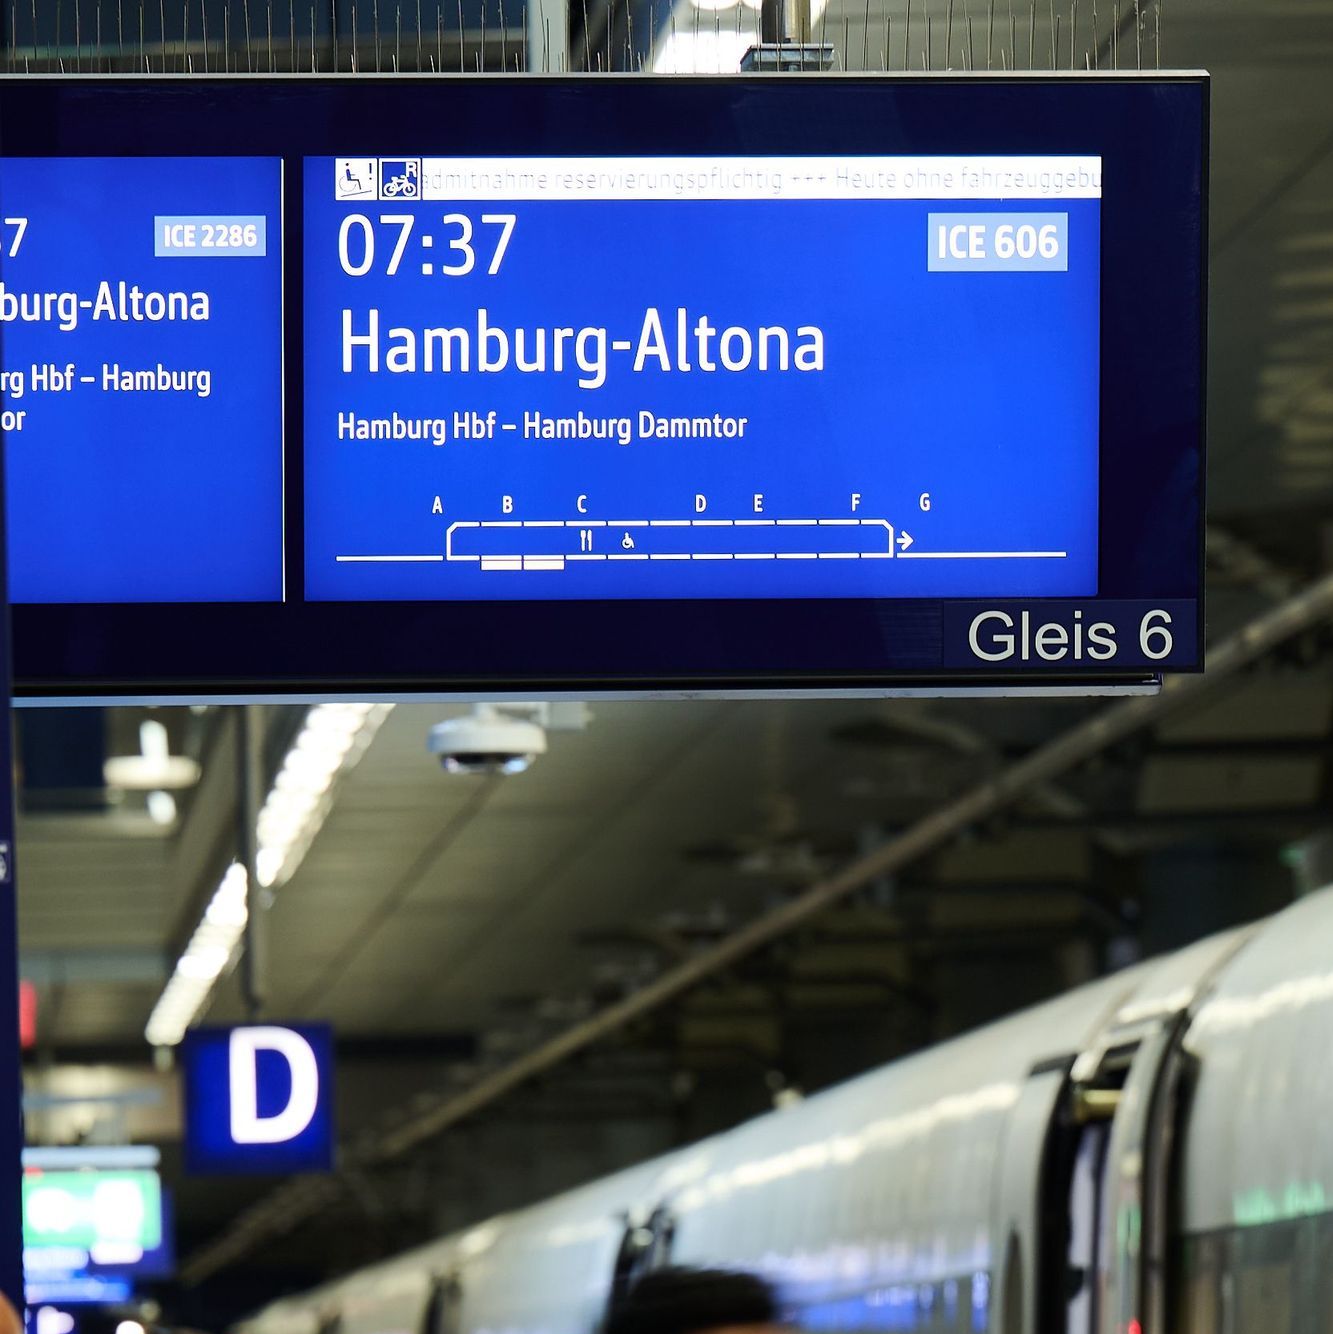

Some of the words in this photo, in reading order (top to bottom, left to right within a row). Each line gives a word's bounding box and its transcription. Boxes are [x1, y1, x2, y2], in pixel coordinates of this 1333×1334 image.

[836, 167, 897, 190] Heute
[903, 167, 954, 190] ohne
[0, 217, 28, 258] 7
[164, 225, 196, 248] ICE
[202, 224, 257, 248] 2286
[338, 213, 517, 277] 07:37
[938, 224, 985, 259] ICE
[994, 224, 1059, 259] 606
[342, 307, 825, 389] Hamburg-Altona
[31, 363, 75, 392] Hbf
[102, 363, 211, 398] Hamburg
[338, 411, 446, 446] Hamburg
[453, 411, 496, 439] Hbf
[524, 410, 632, 445] Hamburg
[638, 410, 748, 439] Dammtor
[432, 495, 443, 514] A
[502, 495, 513, 514] B
[577, 494, 587, 513] C
[695, 494, 706, 513] D
[754, 494, 763, 513] E
[851, 493, 861, 512] F
[919, 492, 931, 512] G
[968, 609, 1118, 661] Gleis
[1139, 610, 1173, 661] 6
[229, 1026, 319, 1144] D
